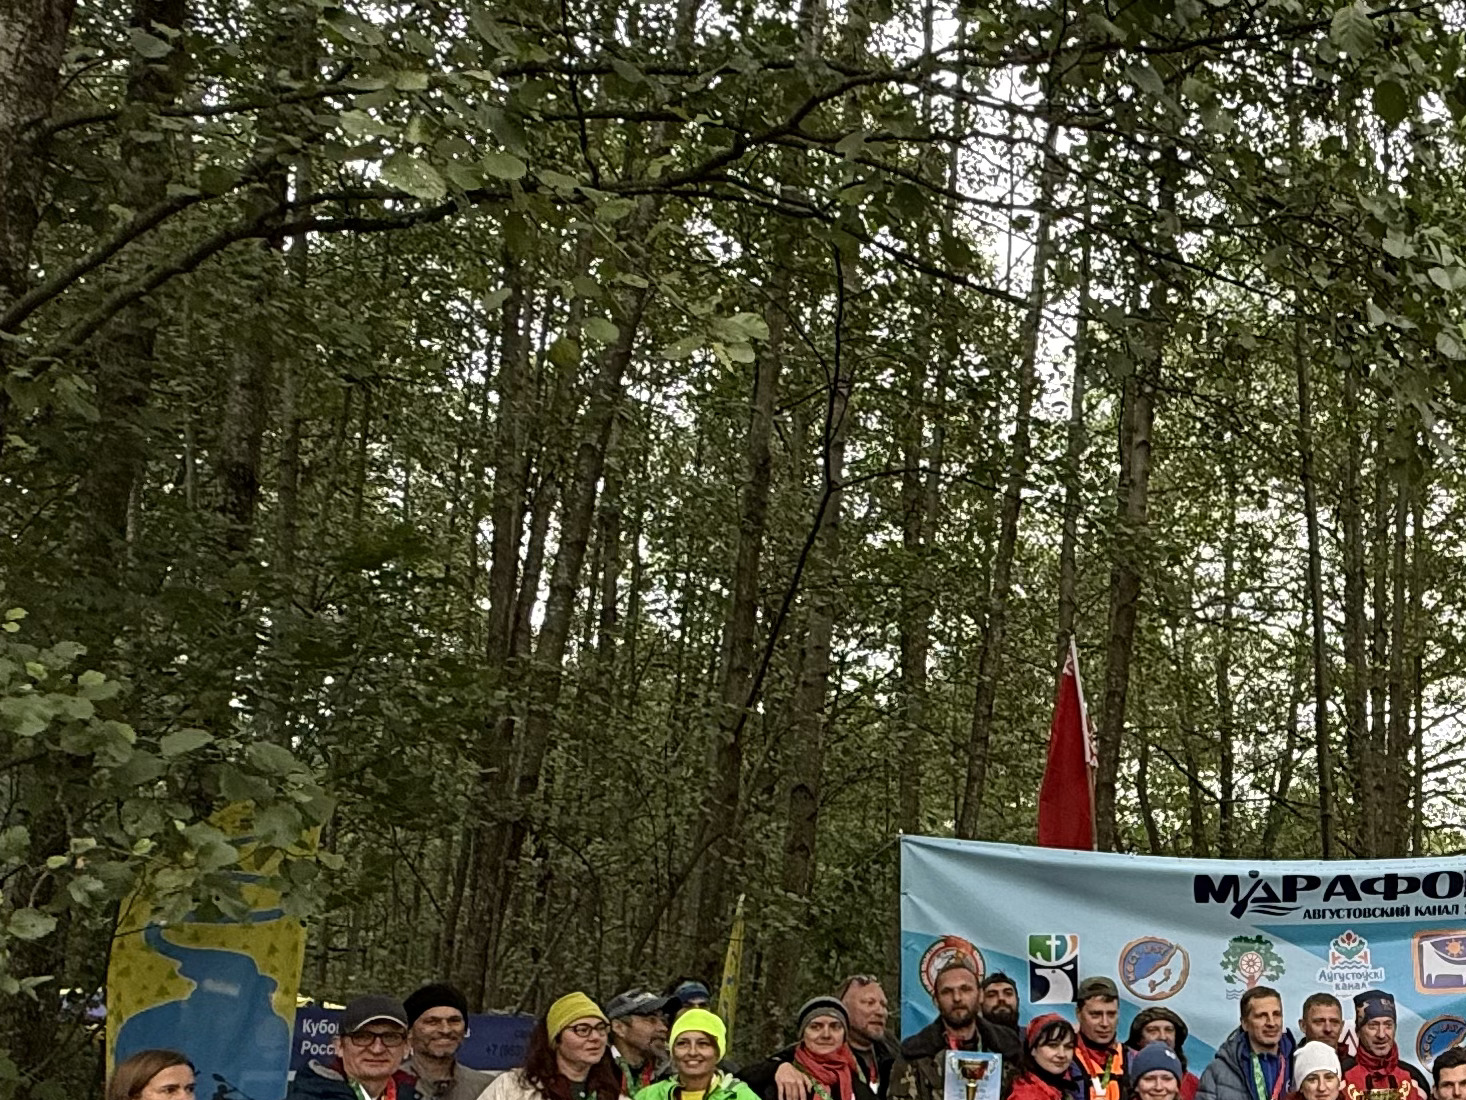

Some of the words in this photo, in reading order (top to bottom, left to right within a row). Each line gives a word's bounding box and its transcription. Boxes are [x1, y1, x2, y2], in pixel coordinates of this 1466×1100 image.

[1303, 904, 1410, 920] АВГУСТОВСКИЙ
[1415, 903, 1459, 917] КАНАЛ
[300, 1040, 337, 1056] Росс
